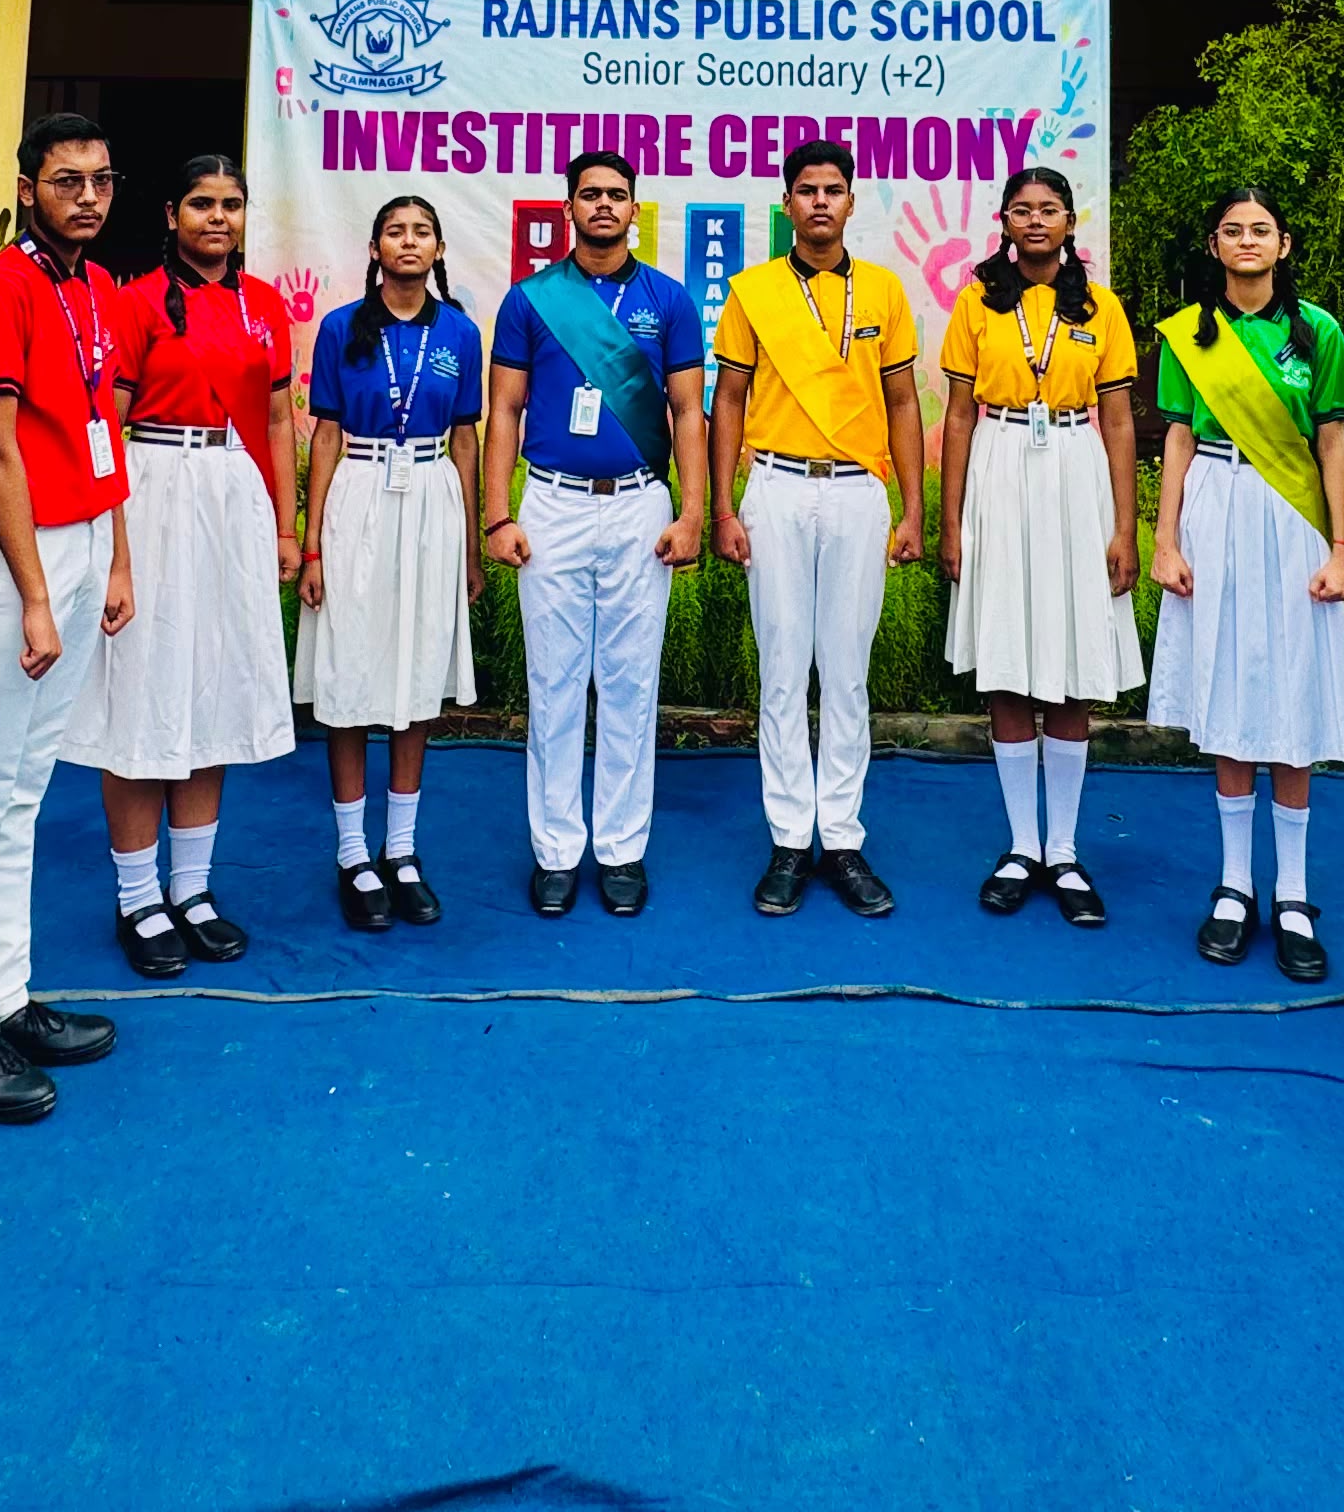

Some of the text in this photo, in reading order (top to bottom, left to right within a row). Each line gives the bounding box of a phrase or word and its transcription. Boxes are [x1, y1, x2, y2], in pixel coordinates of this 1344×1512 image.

[869, 0, 1057, 43] SCHOOL
[339, 73, 415, 88] RAMNAGAR
[582, 51, 945, 97] Senior Secondary (+2)
[322, 109, 693, 177] INVESTITURE
